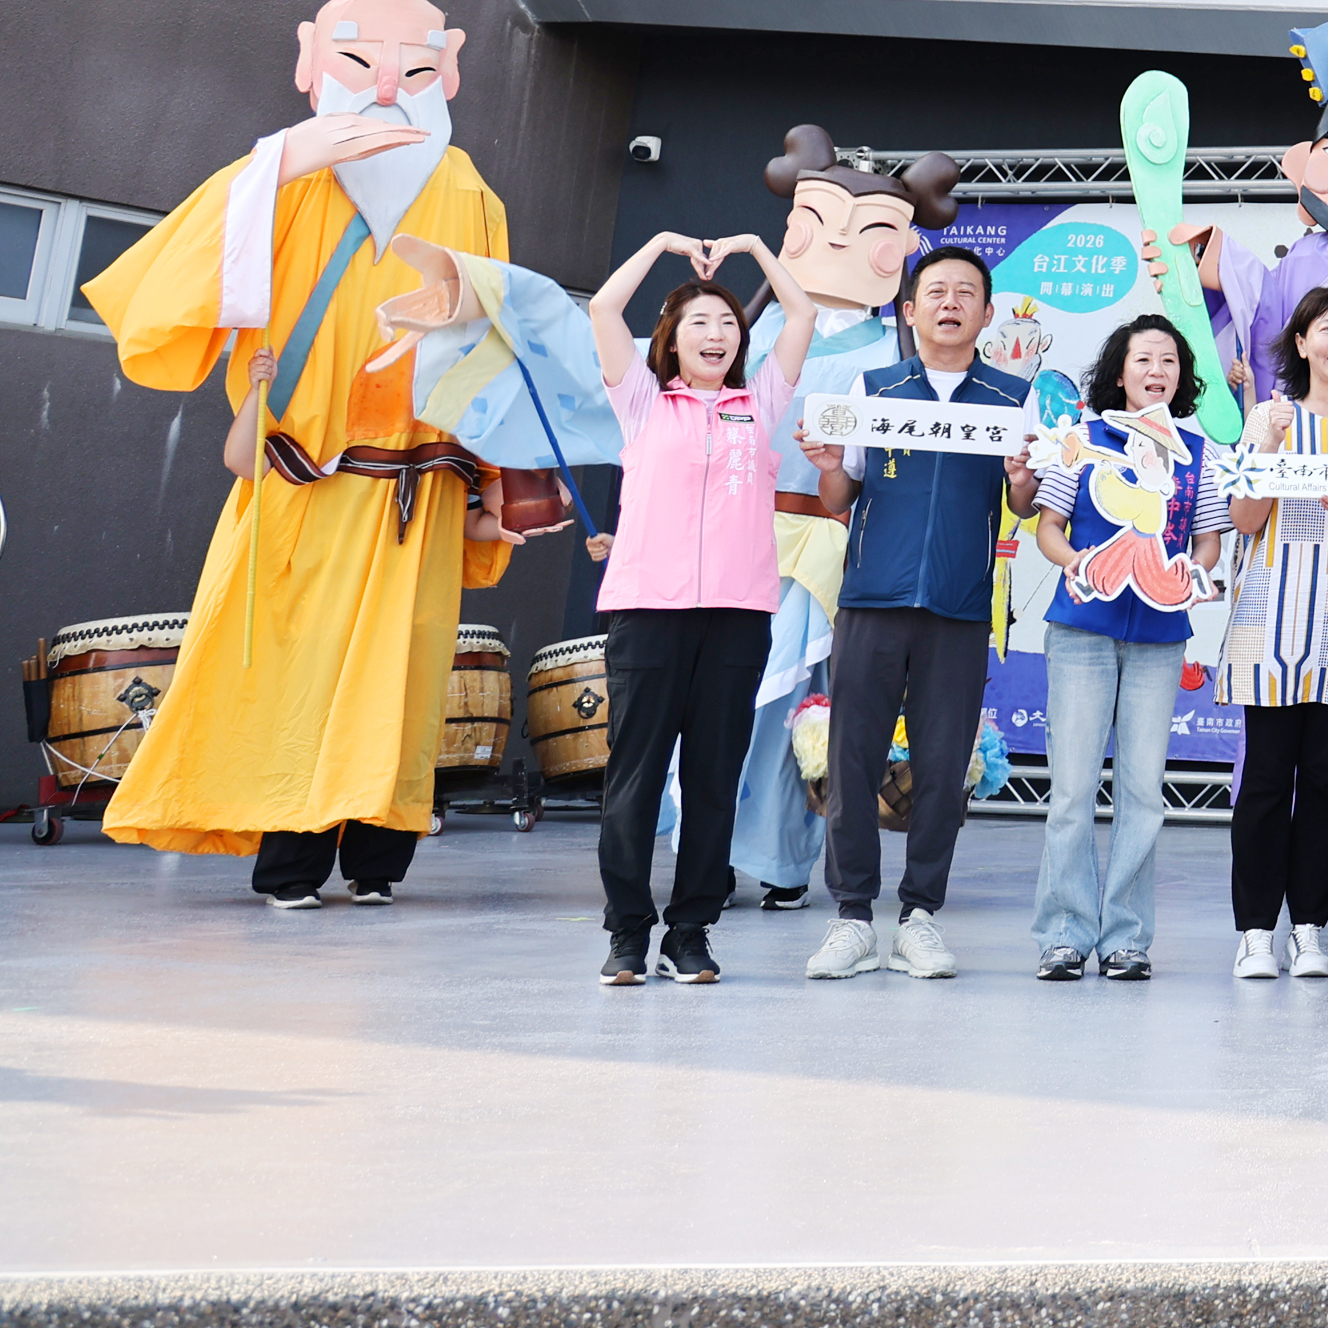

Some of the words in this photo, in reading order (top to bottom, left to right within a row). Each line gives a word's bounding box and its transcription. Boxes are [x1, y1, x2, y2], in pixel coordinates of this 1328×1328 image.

[942, 225, 1007, 236] TAIKANG
[1066, 234, 1104, 248] 2026
[1033, 254, 1127, 274] 台江文化季
[871, 418, 1008, 442] 海尾朝皇宮
[725, 426, 746, 495] 蔡麗青
[745, 424, 757, 485] 台南市議員
[1268, 482, 1300, 491] Cultural
[1301, 482, 1327, 492] Affairs
[1197, 717, 1242, 728] 臺南市政府
